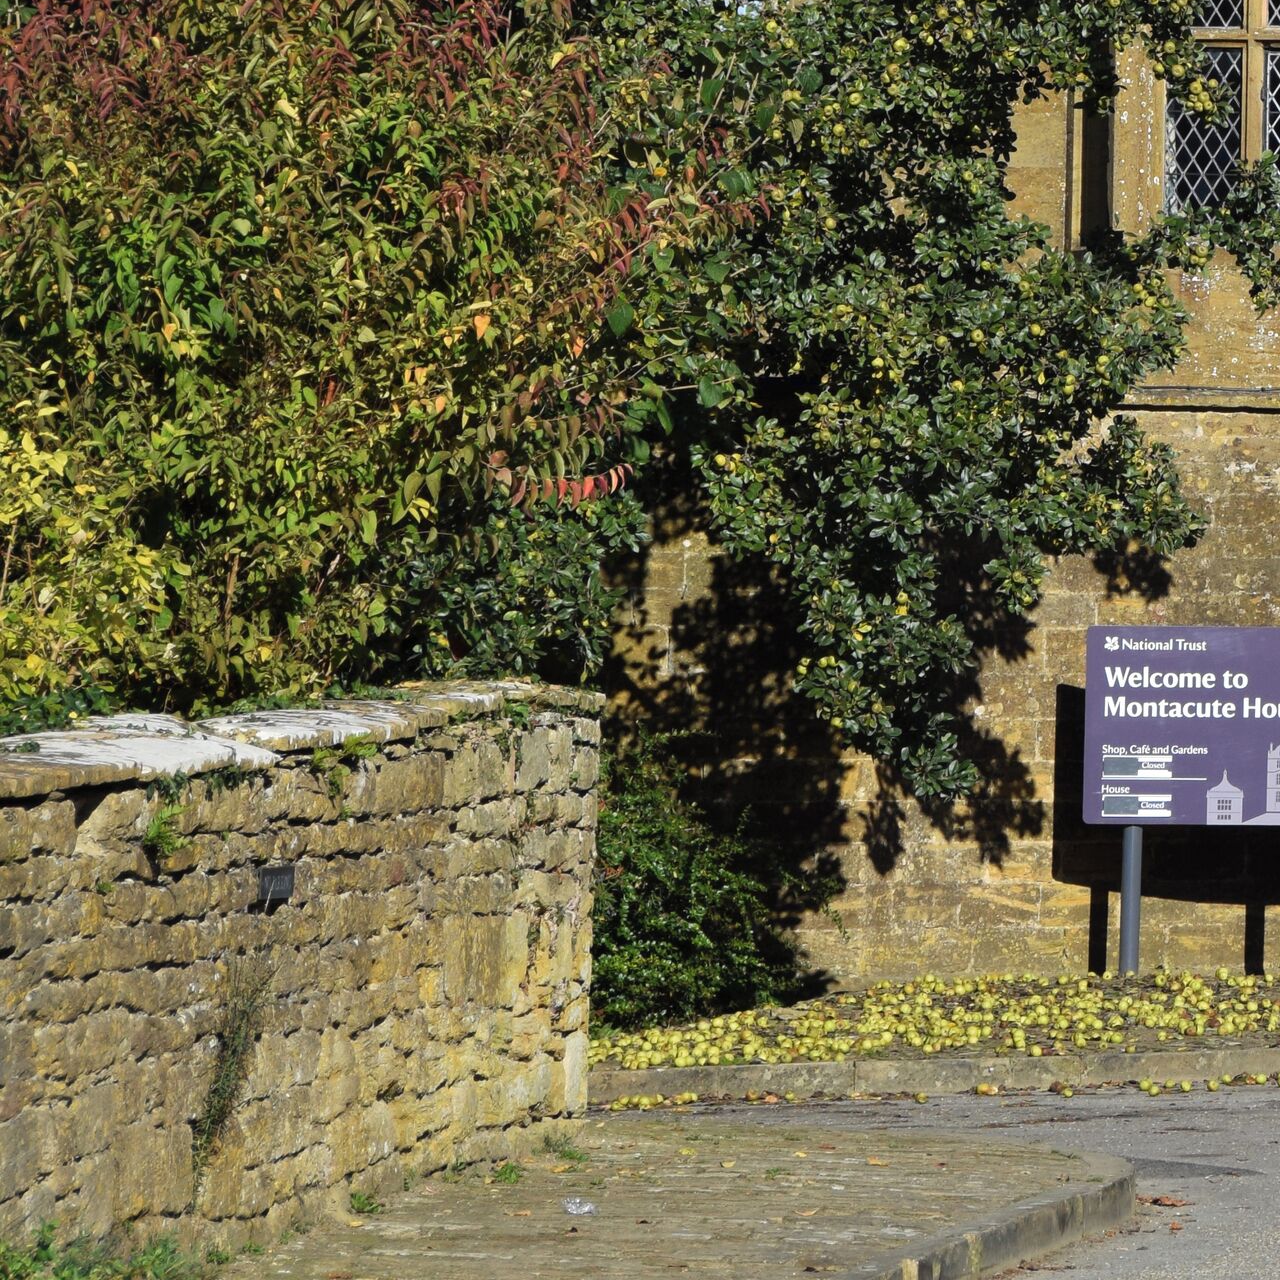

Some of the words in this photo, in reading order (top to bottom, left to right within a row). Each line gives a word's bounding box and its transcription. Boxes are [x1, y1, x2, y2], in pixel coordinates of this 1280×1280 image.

[1122, 638, 1173, 651] National
[1175, 639, 1207, 651] Trust
[1104, 666, 1216, 689] Welcome
[1222, 670, 1249, 689] to
[1104, 696, 1236, 718] Montacute
[1102, 745, 1128, 755] Shop,
[1129, 745, 1151, 754] Café
[1152, 745, 1169, 754] and
[1171, 745, 1208, 755] Gardens
[1101, 785, 1131, 794] House
[1140, 801, 1165, 809] Closed
